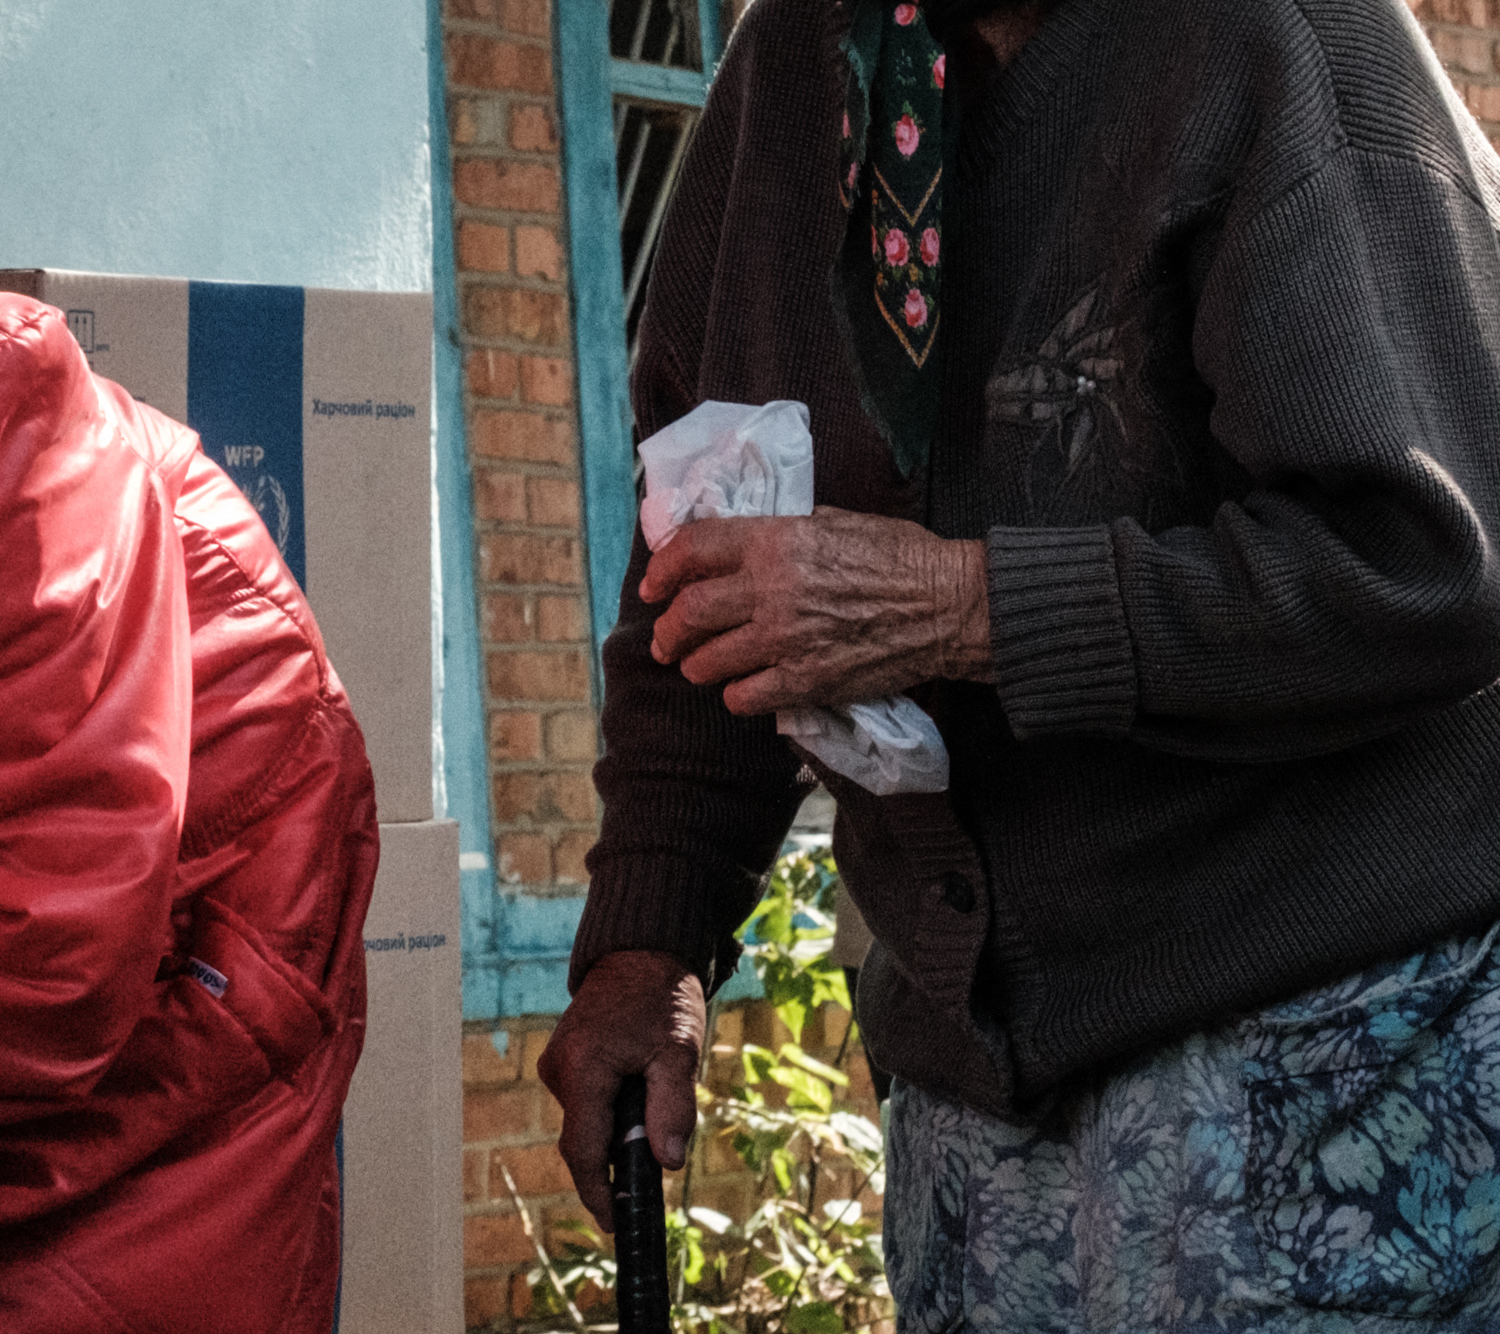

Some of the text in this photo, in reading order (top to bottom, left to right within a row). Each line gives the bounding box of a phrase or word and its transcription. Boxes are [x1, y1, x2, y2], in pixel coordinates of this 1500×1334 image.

[312, 398, 416, 421] Харчовий раціон
[224, 445, 265, 467] WFP
[408, 932, 446, 954] раціон
